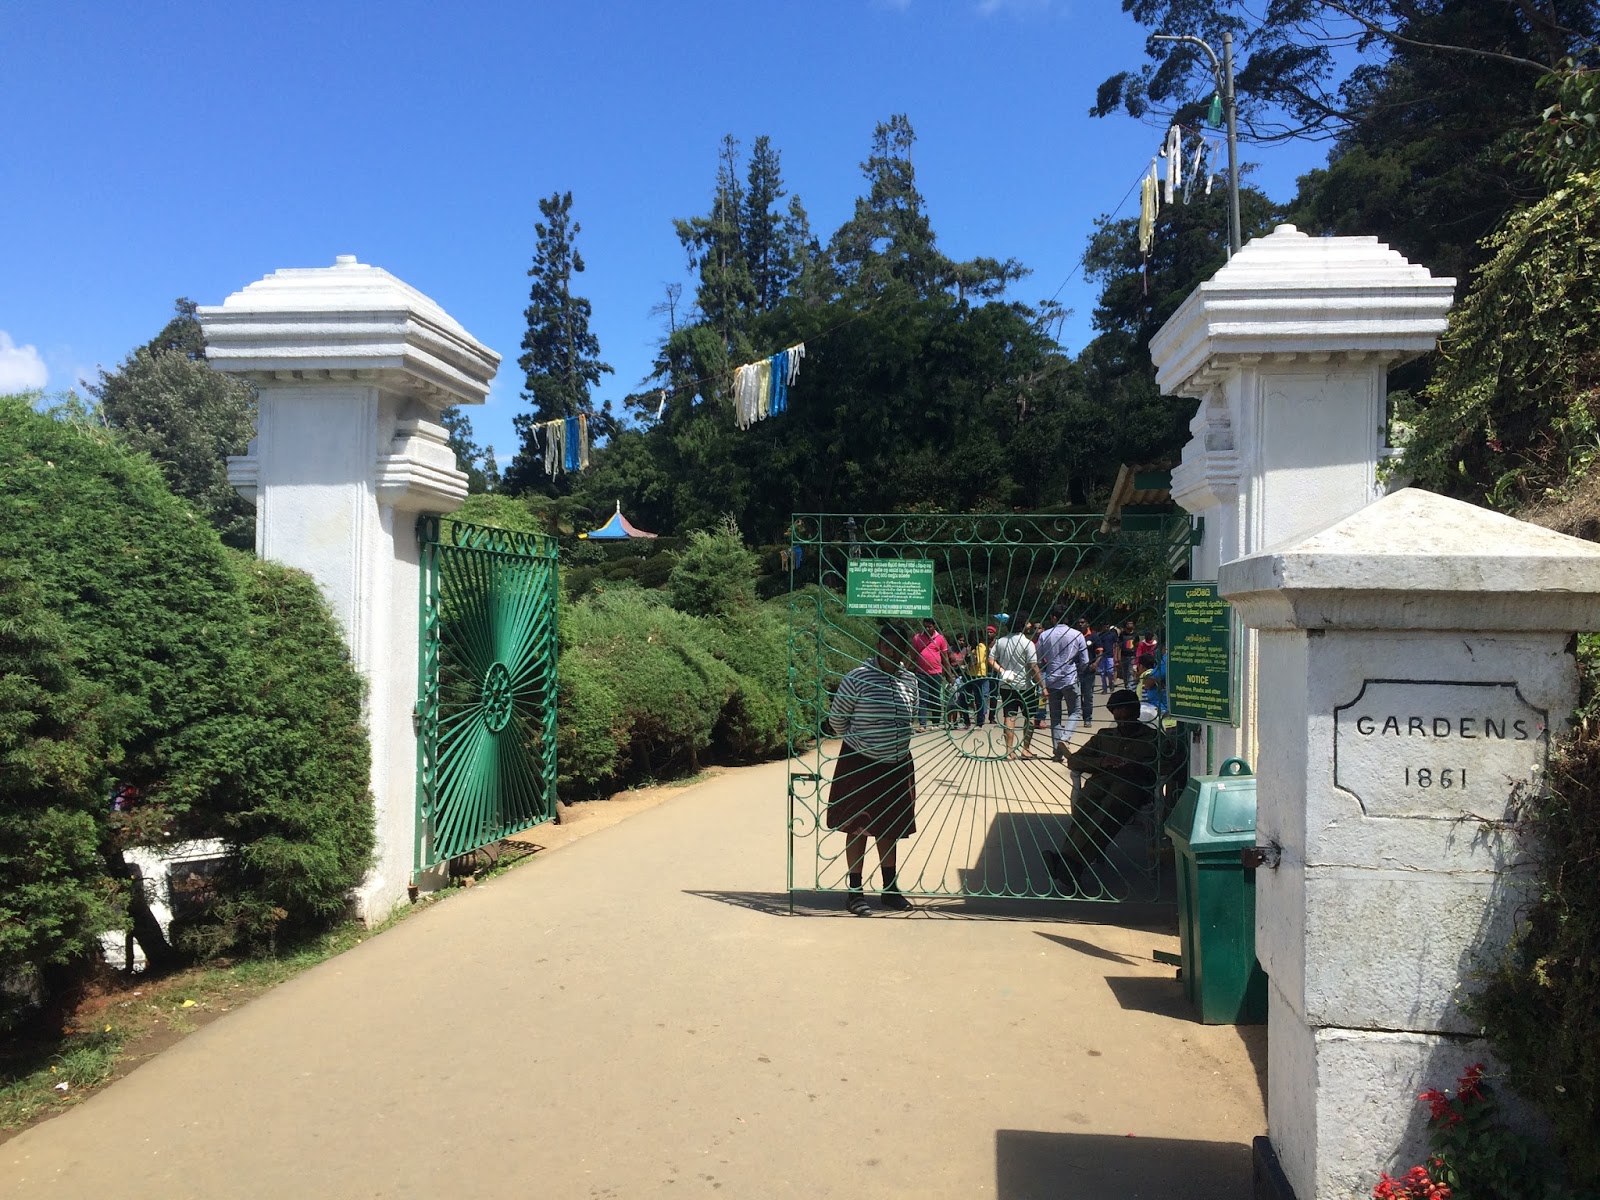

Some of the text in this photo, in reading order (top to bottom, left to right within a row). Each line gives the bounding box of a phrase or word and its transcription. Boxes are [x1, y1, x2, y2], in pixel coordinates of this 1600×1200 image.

[1187, 675, 1209, 684] NOTICE
[1356, 715, 1529, 740] GARDENS
[1405, 767, 1466, 789] 1861
